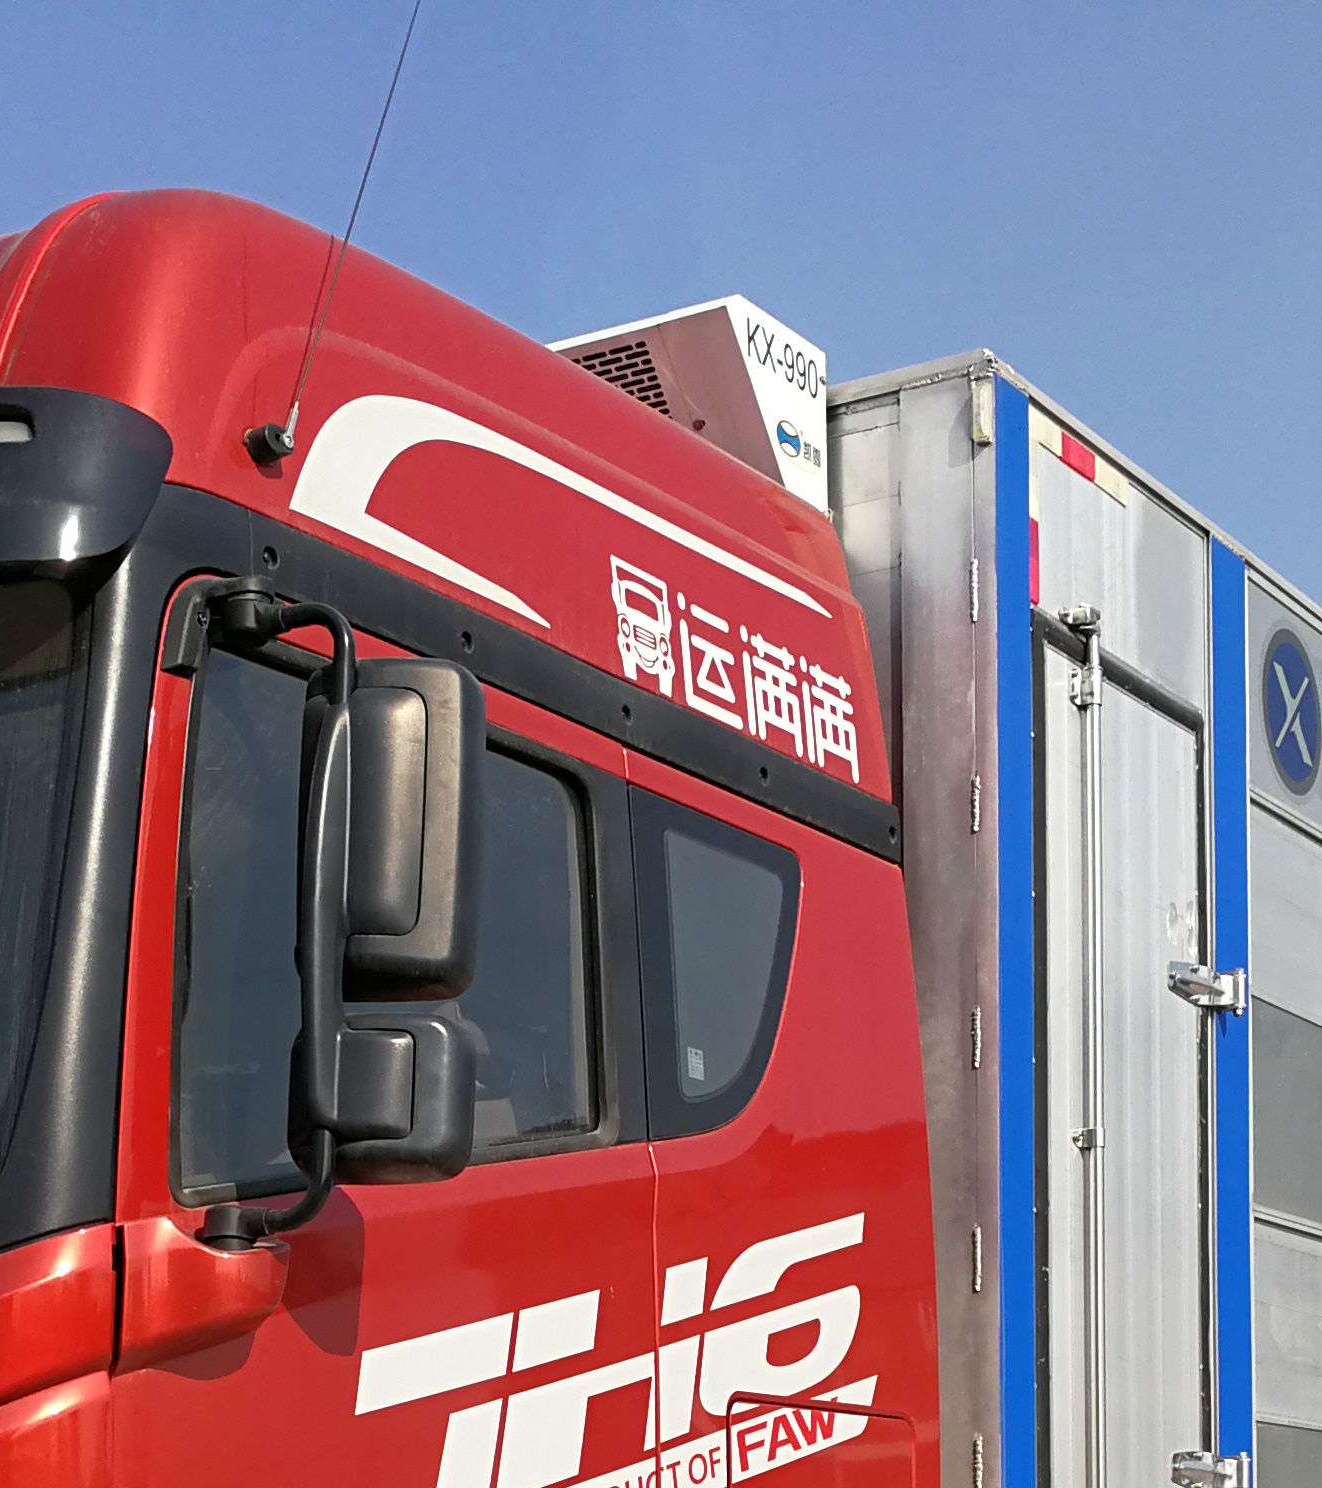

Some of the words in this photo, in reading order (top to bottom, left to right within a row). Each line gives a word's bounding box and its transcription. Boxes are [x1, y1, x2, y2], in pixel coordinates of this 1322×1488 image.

[747, 317, 819, 399] KX-990
[677, 590, 861, 784] 运满满
[688, 1444, 723, 1487] OF
[736, 1397, 838, 1473] FAW
